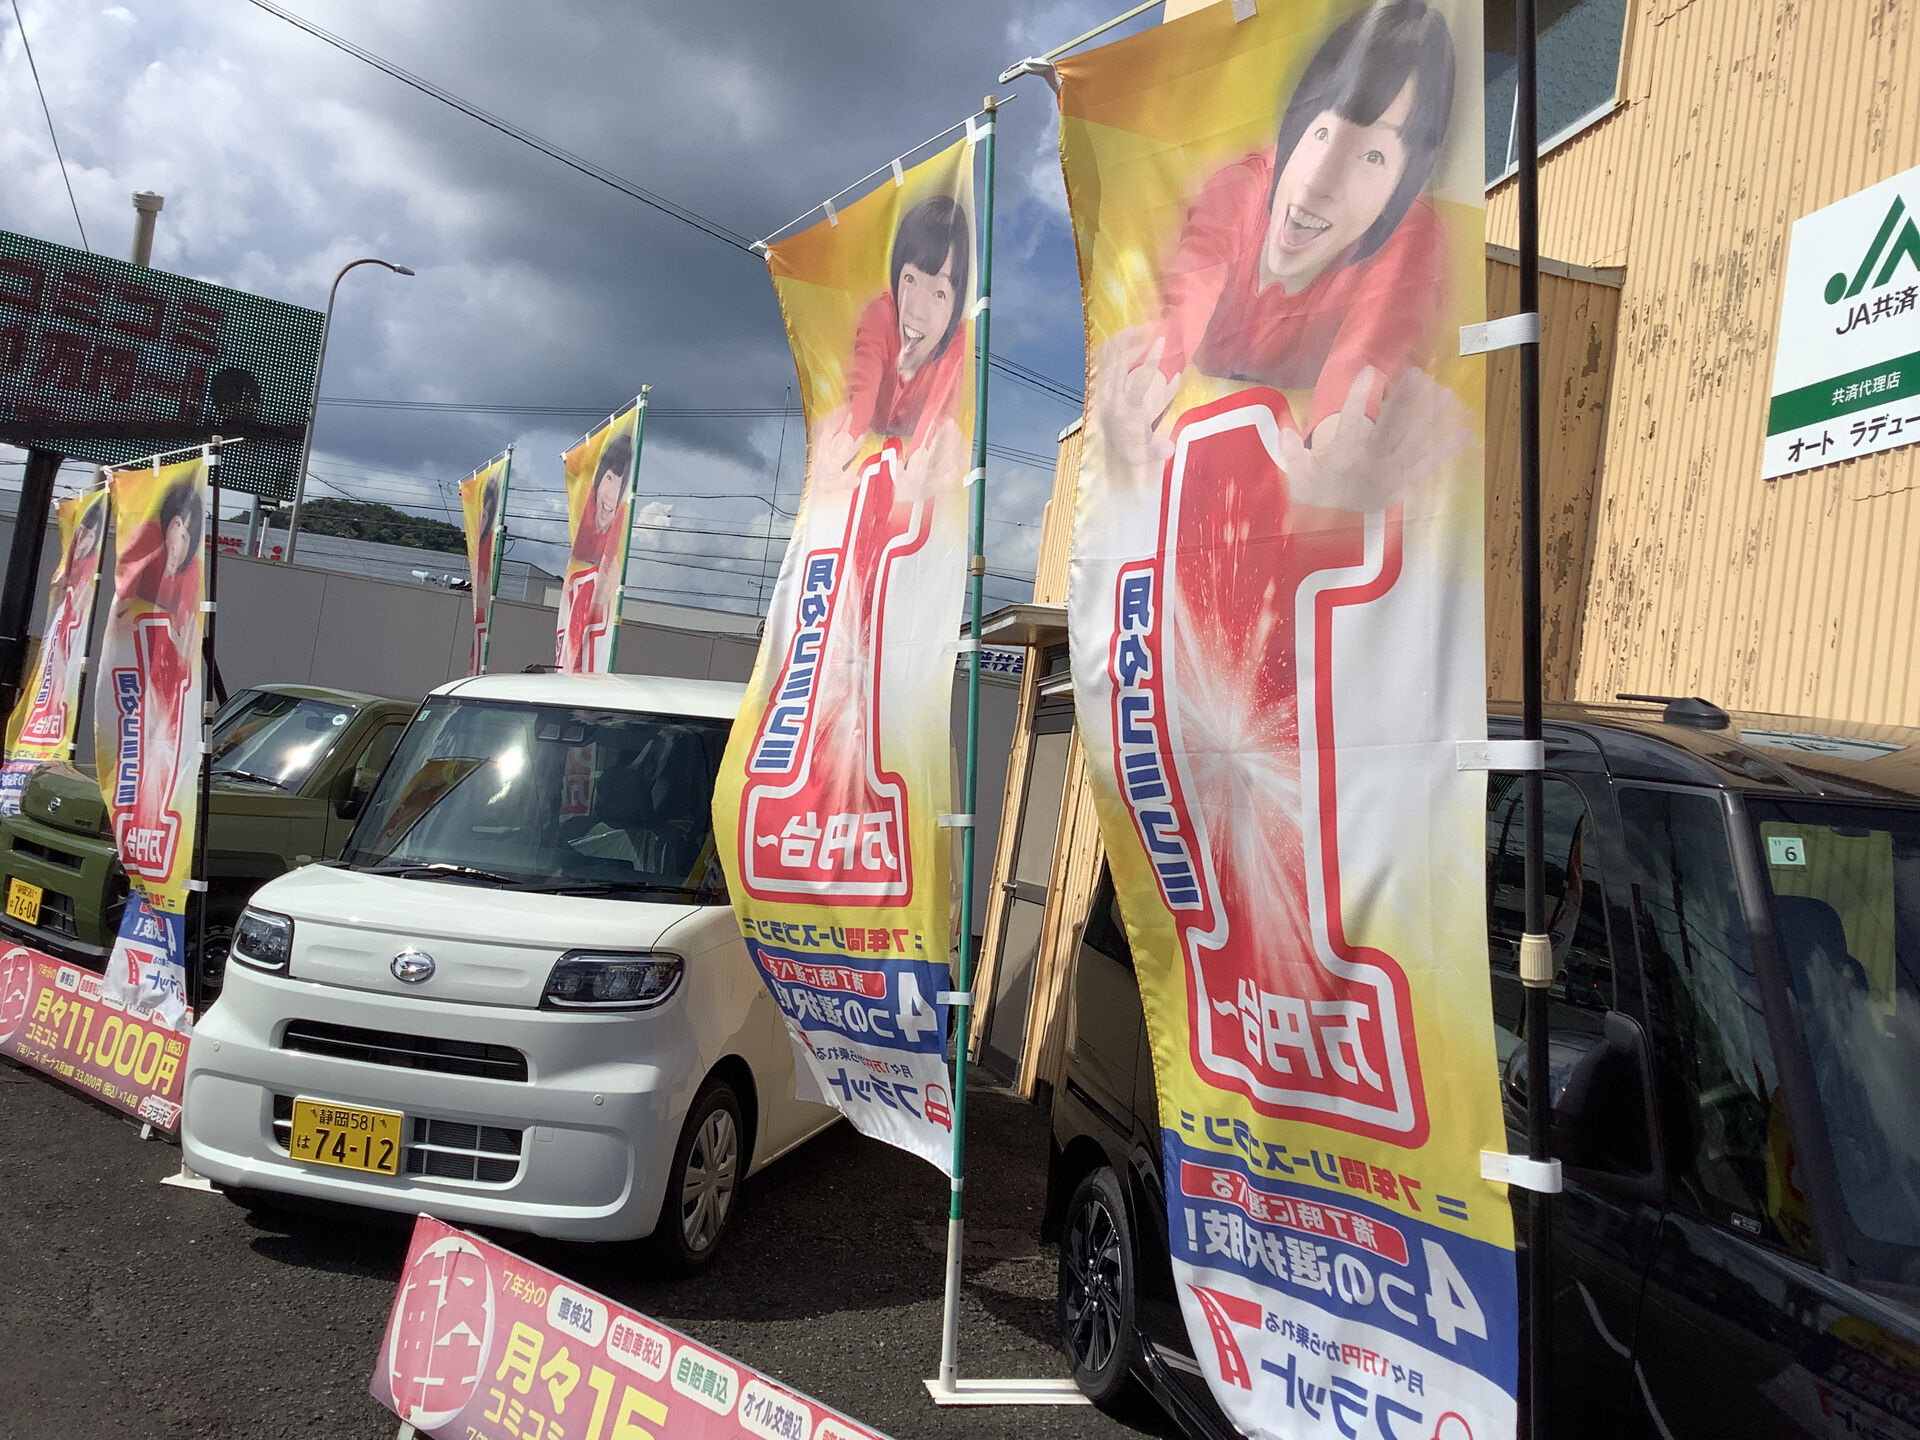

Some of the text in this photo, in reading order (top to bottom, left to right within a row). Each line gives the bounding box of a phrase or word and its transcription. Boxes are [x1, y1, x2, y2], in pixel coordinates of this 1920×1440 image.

[1836, 285, 1918, 335] JA共済
[1832, 371, 1901, 406] 共済代理店
[1787, 430, 1835, 463] オート
[1785, 846, 1797, 861] 6
[26, 1022, 59, 1050] コミコミ
[296, 1128, 394, 1171] は 74-12
[502, 1270, 803, 1440] 7年分の 車検込 自動車税込 自賠責込 オイル交換込
